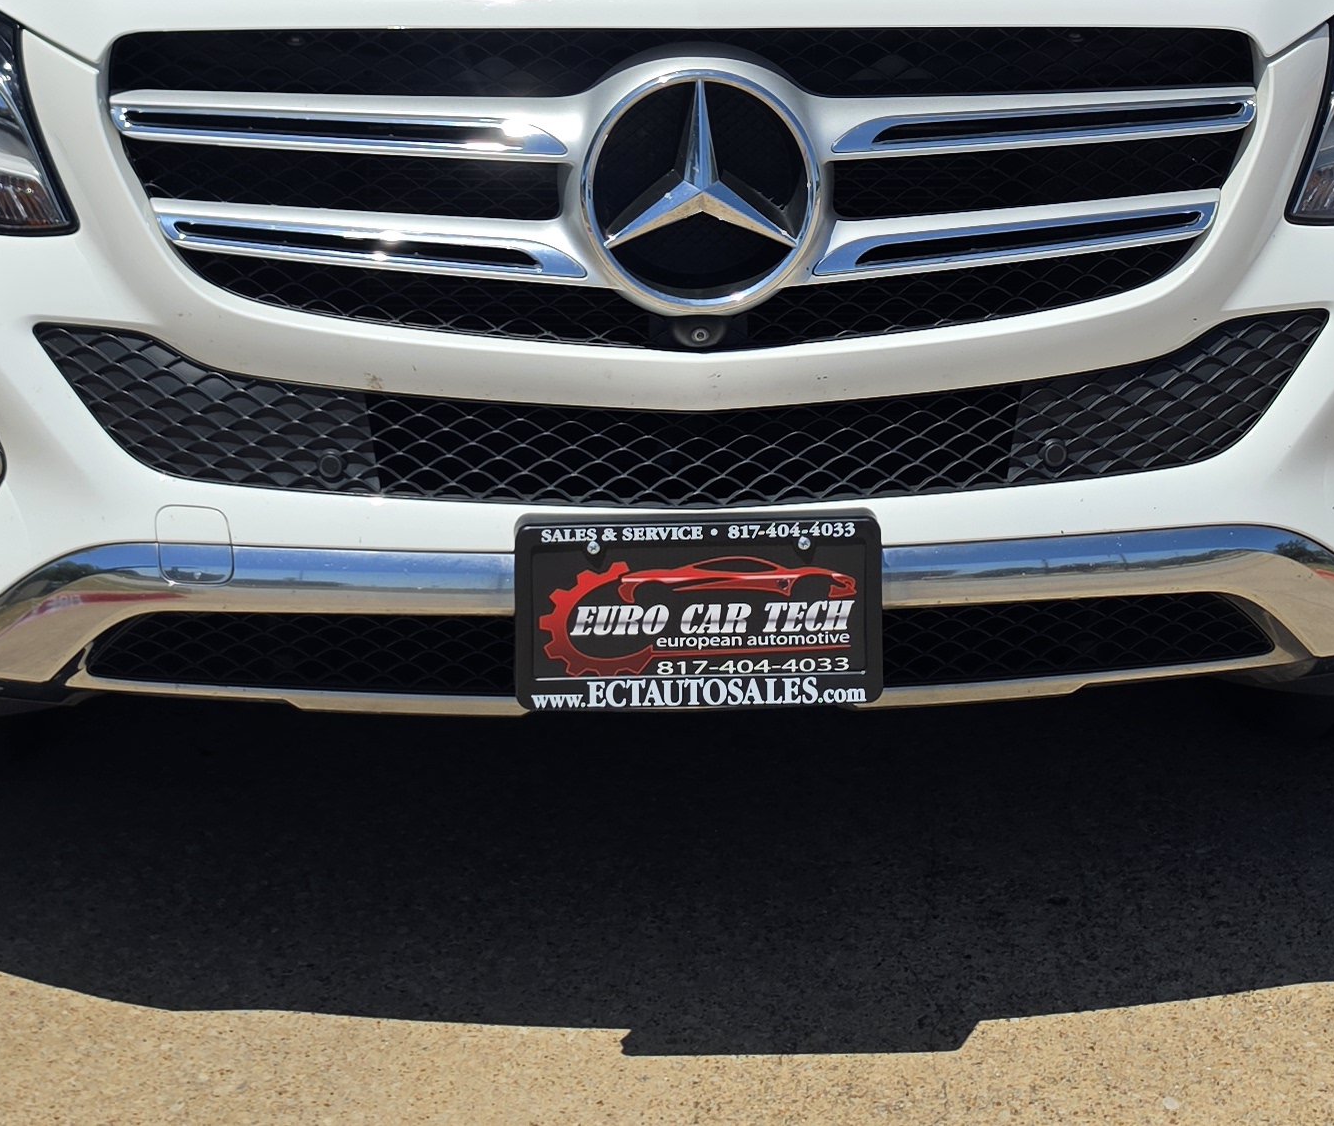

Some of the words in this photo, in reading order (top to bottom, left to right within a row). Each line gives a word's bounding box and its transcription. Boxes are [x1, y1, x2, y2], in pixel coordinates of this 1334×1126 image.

[540, 527, 598, 543] SALES
[601, 529, 617, 542] &
[622, 526, 704, 542] SERVICE
[727, 522, 856, 540] 817-404-4033
[569, 603, 670, 637] EURO
[680, 601, 752, 635] CAR
[761, 599, 855, 633] TECH
[656, 634, 743, 650] european
[746, 630, 851, 647] automotive
[656, 656, 851, 676] 817-404-4033
[531, 677, 867, 710] www.ECTAUTOSALES.com
